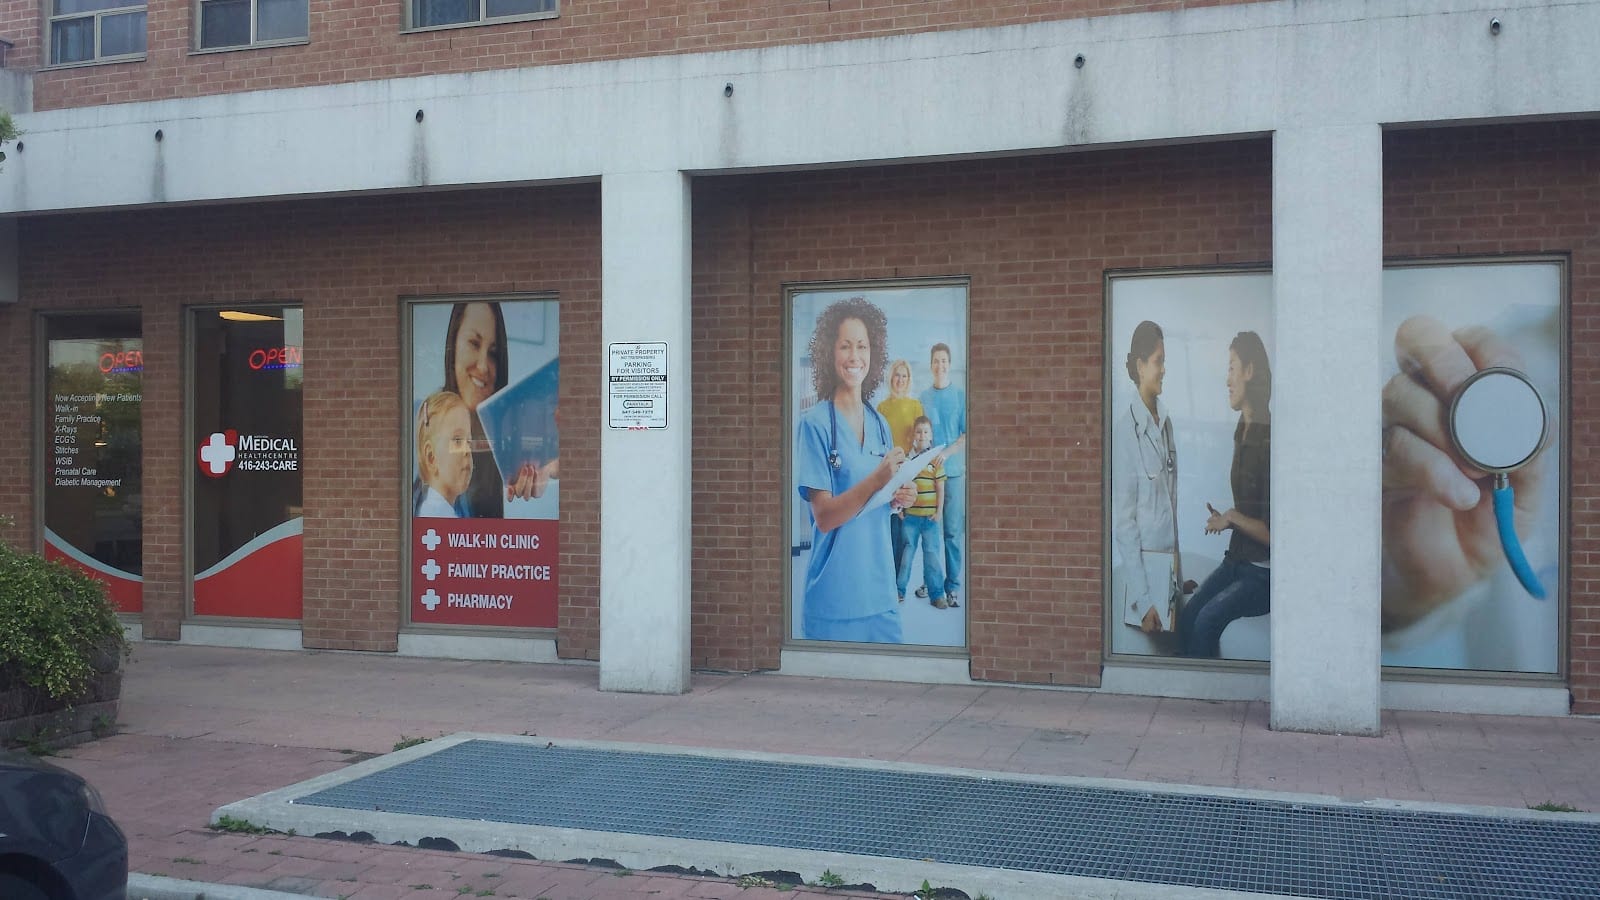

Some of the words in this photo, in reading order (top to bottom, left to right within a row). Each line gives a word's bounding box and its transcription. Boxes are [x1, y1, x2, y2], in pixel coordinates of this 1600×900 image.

[248, 347, 301, 369] OPEN
[55, 394, 69, 402] Now
[116, 394, 142, 402] Patients
[55, 404, 79, 413] Walk-in
[55, 414, 75, 424] Family
[76, 414, 101, 423] Practice
[55, 425, 78, 434] X-Rays
[55, 446, 79, 454] Stitches
[238, 460, 298, 471] 416-243-CARE
[55, 467, 80, 476] Prenatal
[81, 467, 97, 476] Care
[55, 478, 80, 486] Diabetic
[80, 478, 122, 488] Management
[447, 533, 497, 549] WALK-IN
[500, 534, 540, 549] CLINIC
[447, 563, 489, 579] FAMILY
[491, 564, 551, 580] PRACTICE
[447, 593, 514, 610] PHARMACY
